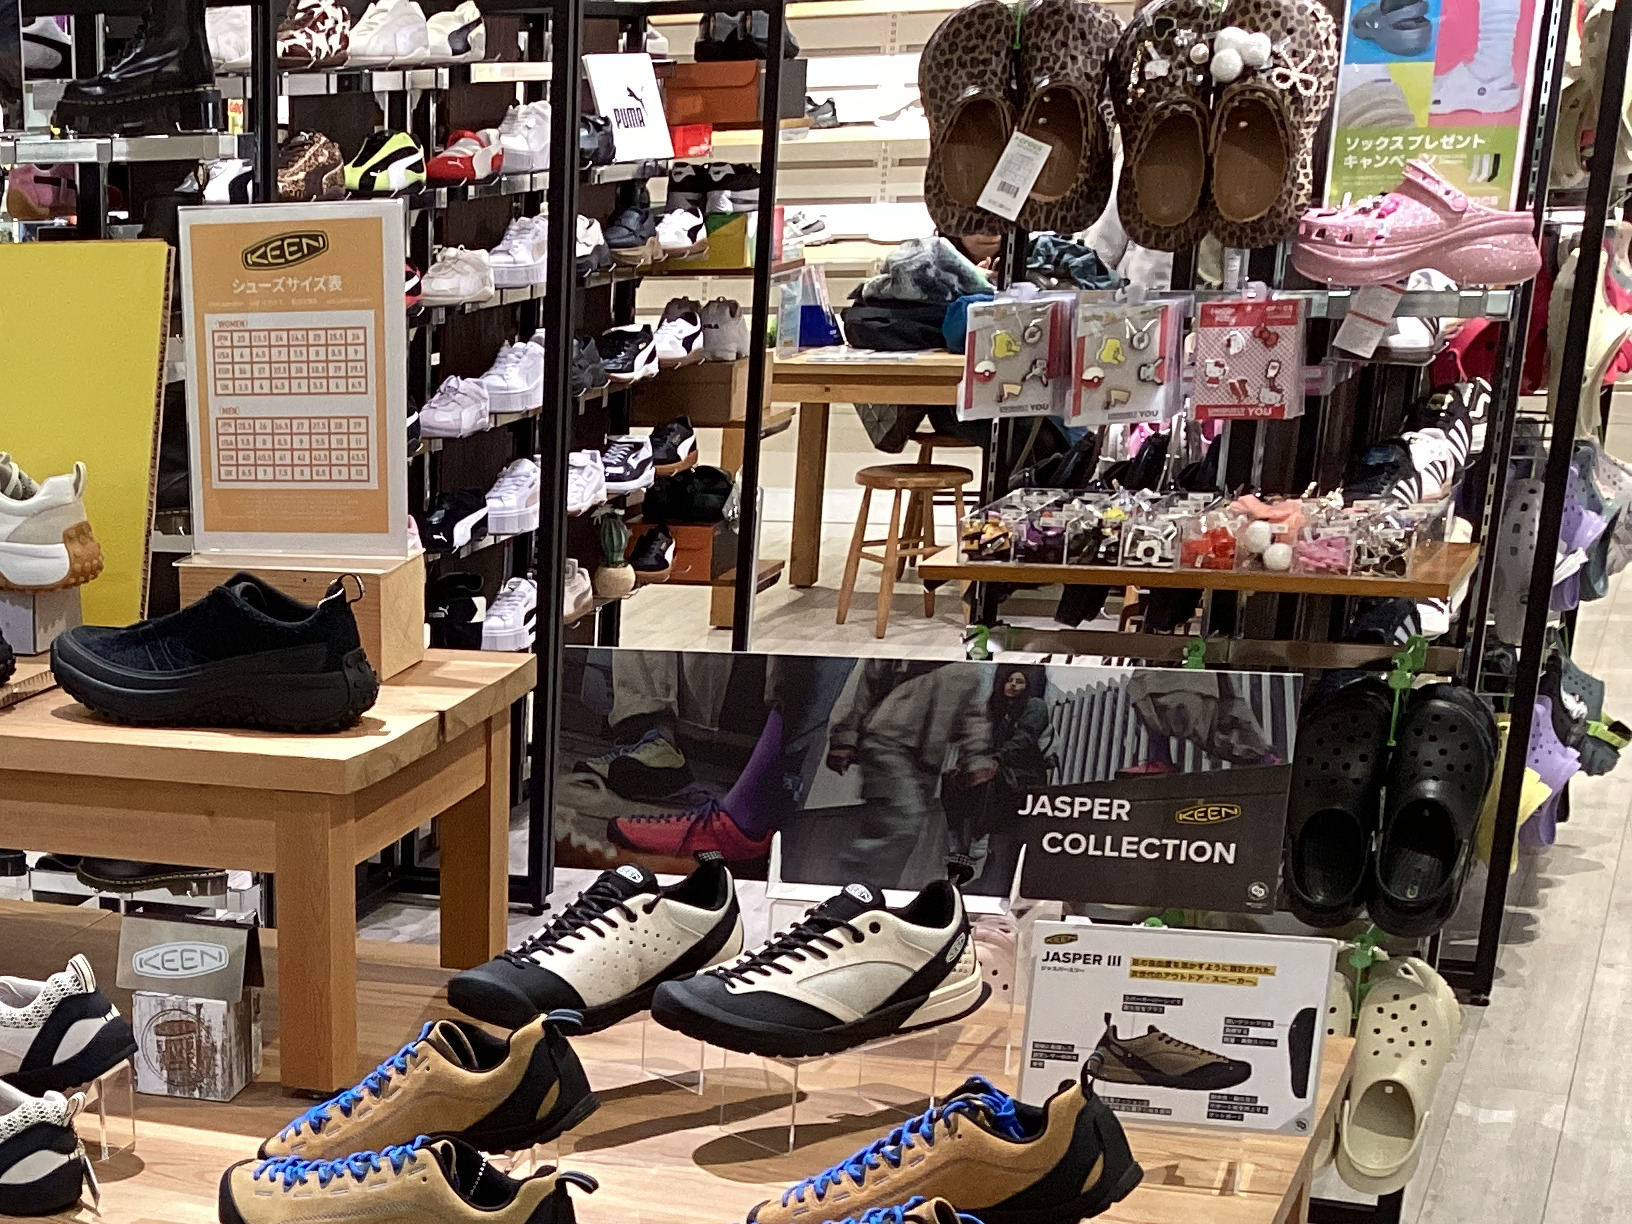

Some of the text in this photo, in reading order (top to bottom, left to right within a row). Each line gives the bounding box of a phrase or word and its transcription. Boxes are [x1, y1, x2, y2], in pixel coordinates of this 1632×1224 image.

[614, 108, 645, 129] PUMA
[1346, 133, 1485, 151] ソックス プレゼント
[1343, 154, 1436, 169] キャンペン
[247, 236, 324, 265] KEEN
[232, 275, 343, 294] シューズサイズ表
[1030, 402, 1049, 412] YOU
[1139, 409, 1159, 419] YOU
[1248, 406, 1272, 416] YOU
[1018, 794, 1238, 821] JASPER KEEN
[1042, 831, 1236, 864] COLLECTION
[139, 948, 222, 972] KEEN
[1042, 951, 1121, 966] JASPER III
